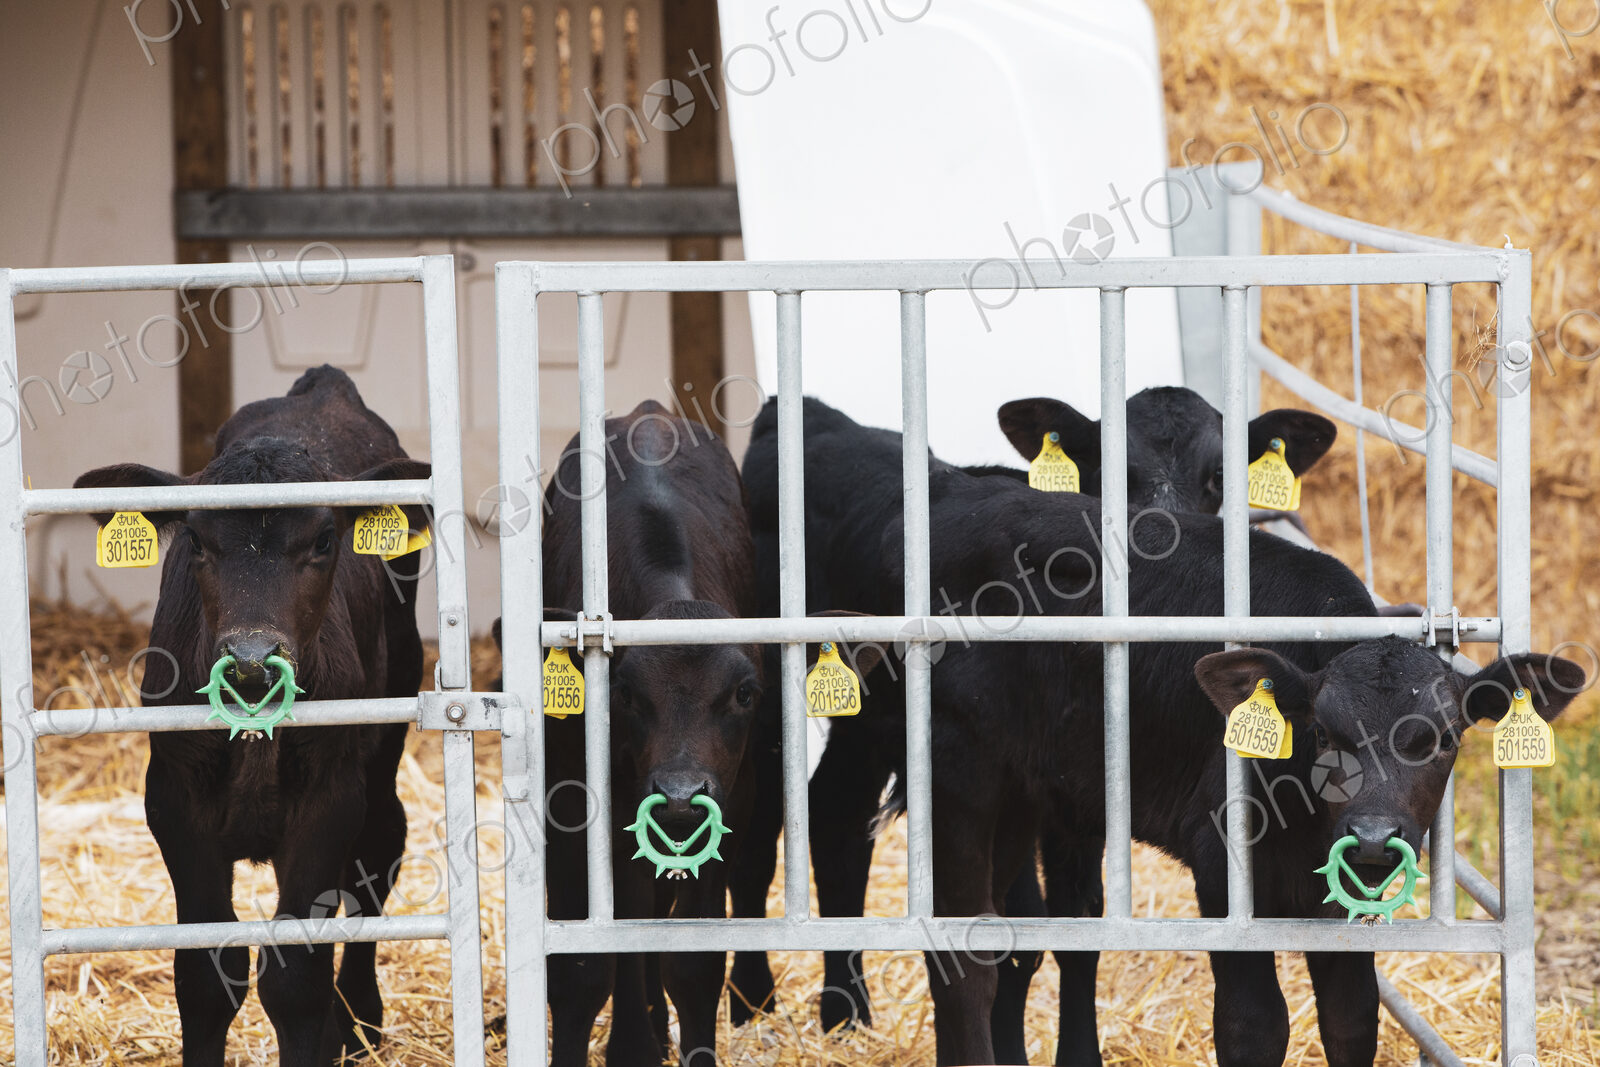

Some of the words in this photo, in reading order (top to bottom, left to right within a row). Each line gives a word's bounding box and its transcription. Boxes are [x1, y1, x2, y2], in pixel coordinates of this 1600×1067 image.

[126, 515, 140, 526] UK
[363, 517, 400, 529] 281005
[110, 527, 148, 540] 281005
[357, 528, 403, 551] 301557
[106, 539, 153, 563] 301557
[556, 663, 570, 674] UK
[828, 667, 842, 677] UK
[543, 675, 576, 686] 81005
[813, 677, 850, 691] 281005
[543, 686, 580, 709] 01556
[810, 687, 857, 713] 201556
[1259, 704, 1273, 717] UK
[1237, 711, 1278, 731] 281005
[1519, 713, 1533, 724] UK
[1228, 721, 1279, 754] 501559
[1502, 725, 1541, 738] 281005
[1498, 737, 1546, 762] 501559
